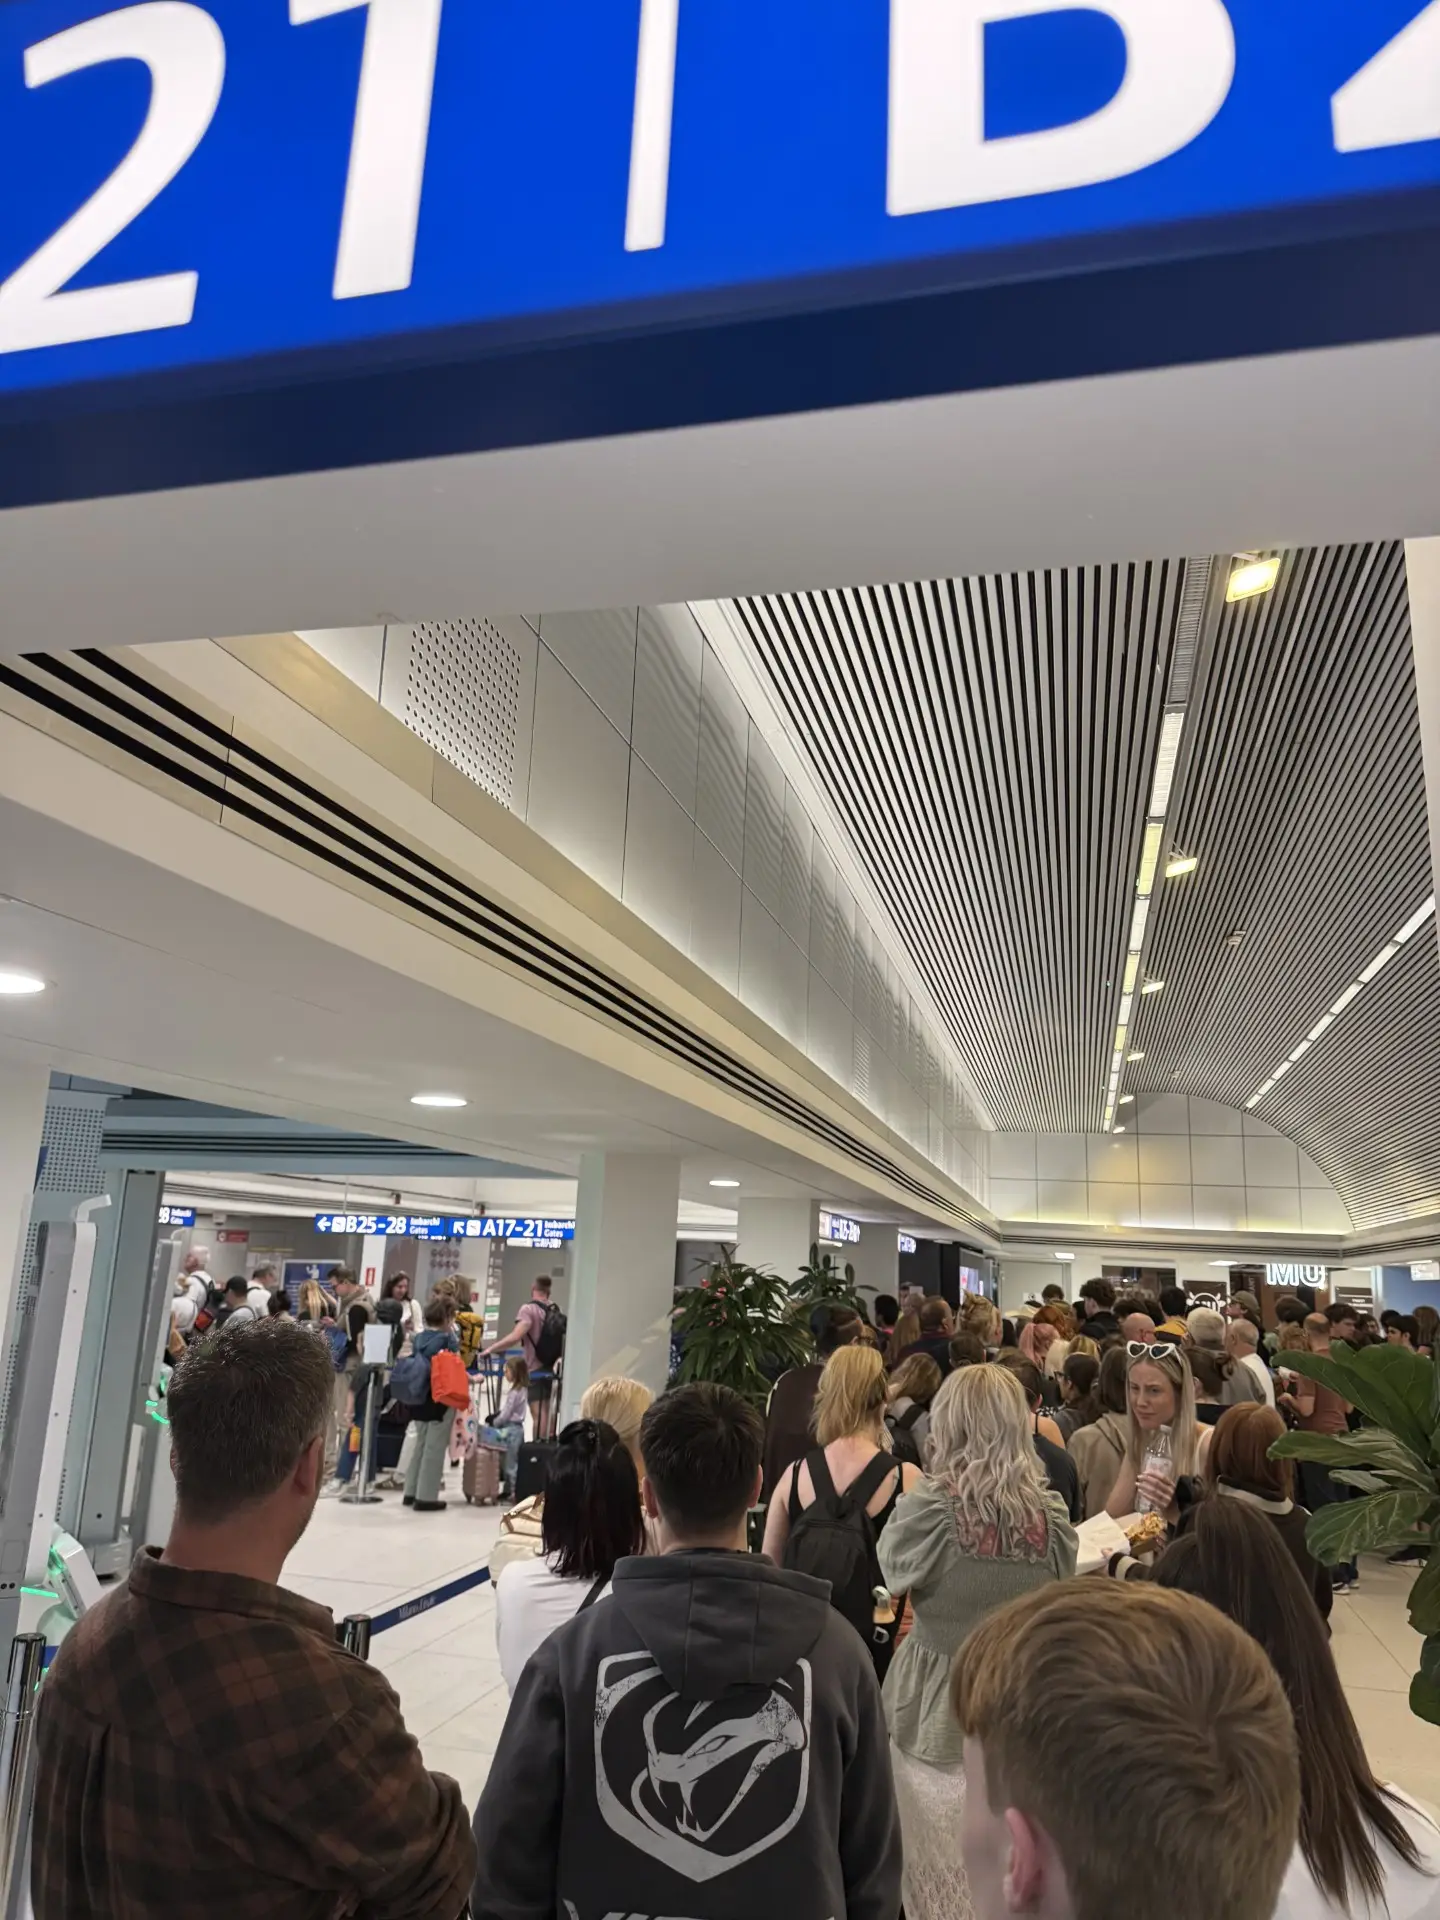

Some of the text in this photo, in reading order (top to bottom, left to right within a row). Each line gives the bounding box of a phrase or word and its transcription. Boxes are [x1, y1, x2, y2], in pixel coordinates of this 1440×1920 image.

[0, 0, 442, 354] 21
[345, 1216, 407, 1234] B25-28
[482, 1218, 543, 1238] A17-21
